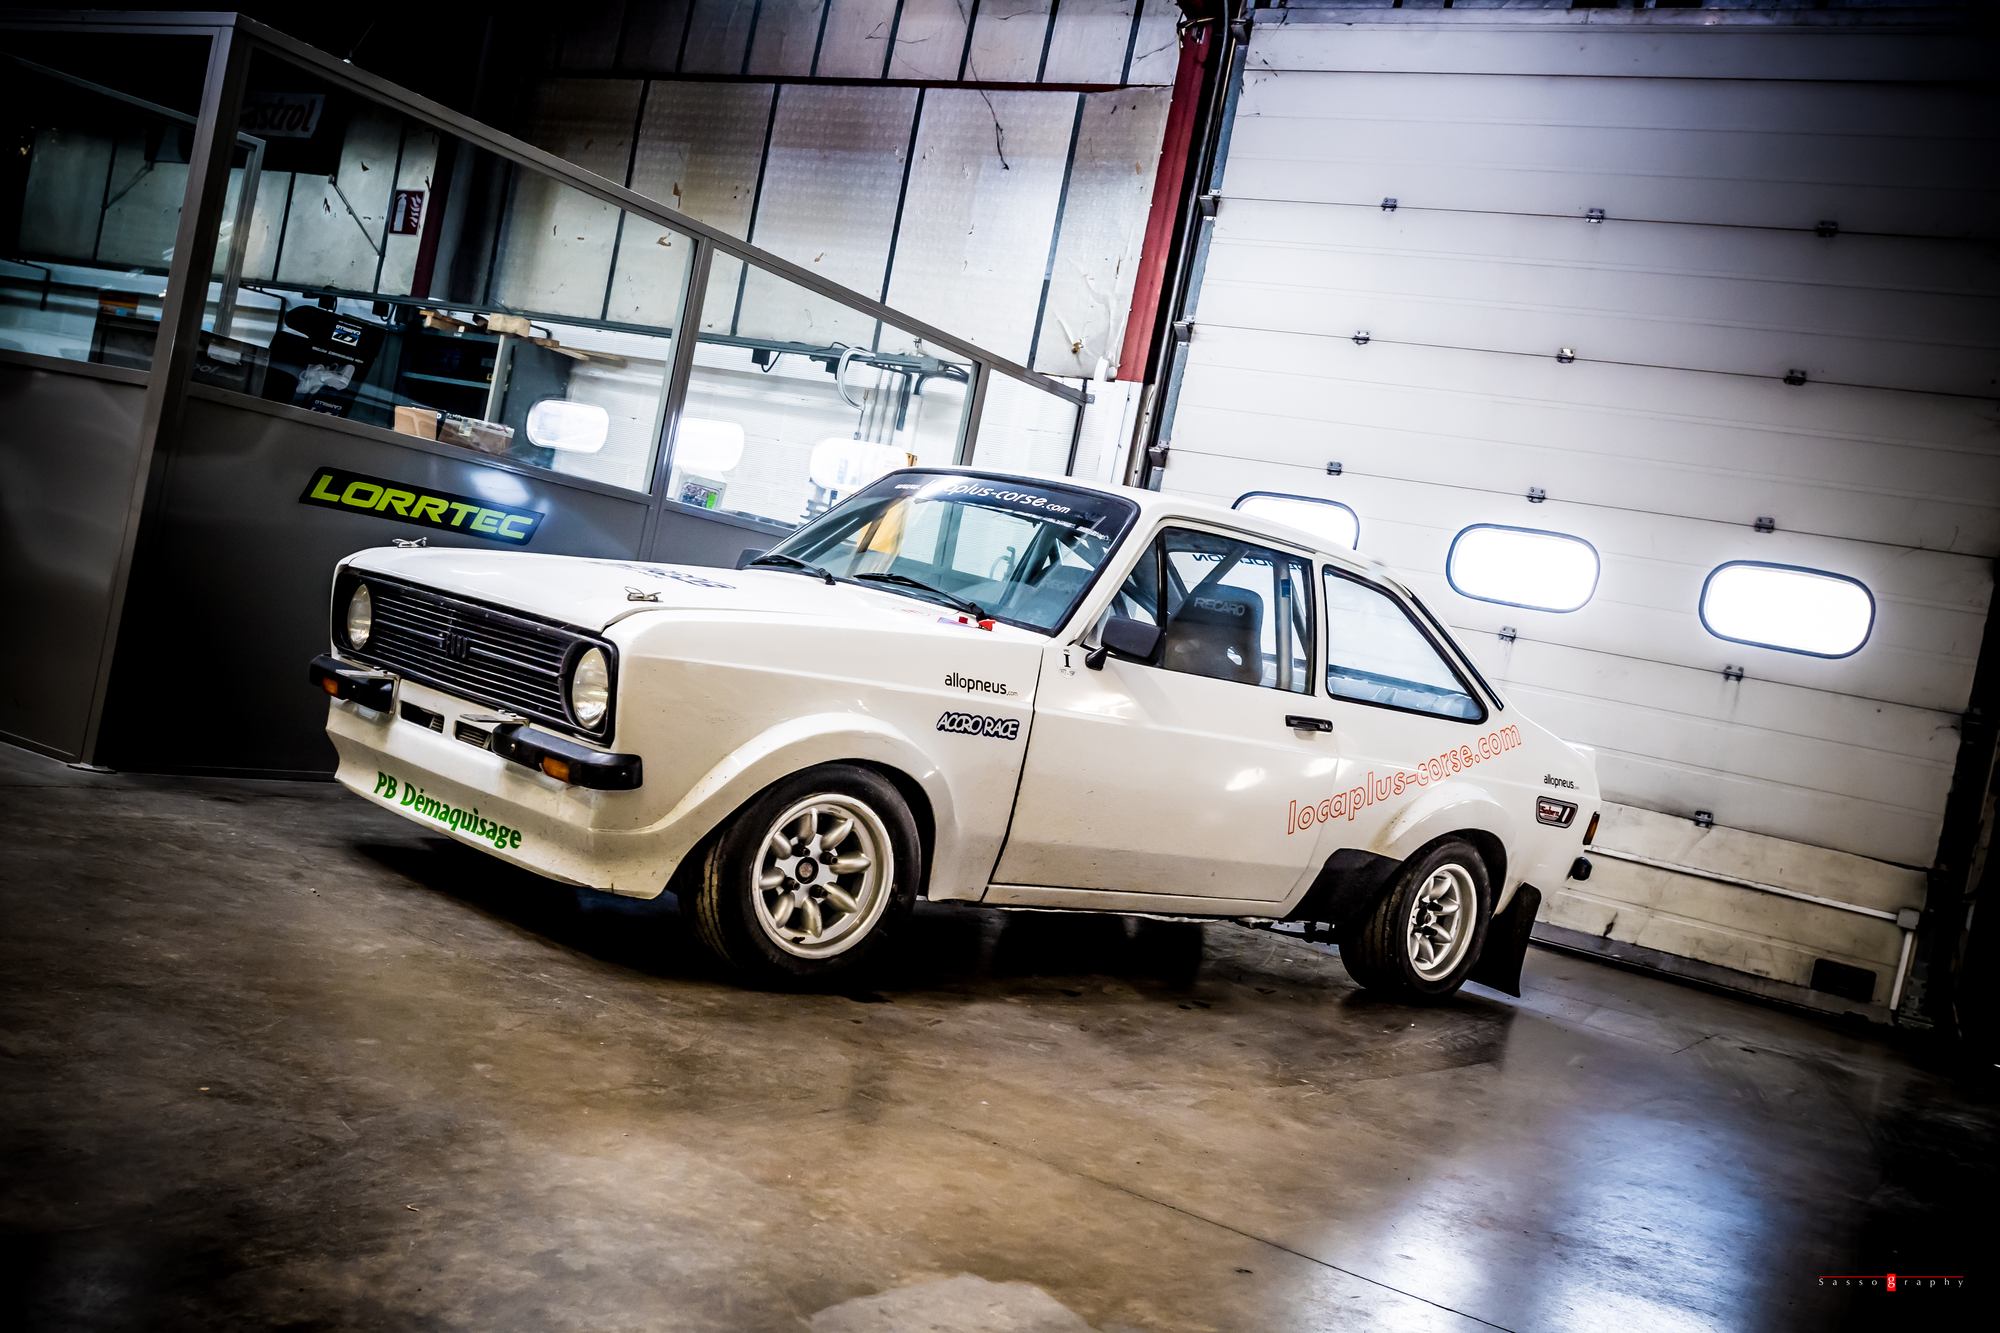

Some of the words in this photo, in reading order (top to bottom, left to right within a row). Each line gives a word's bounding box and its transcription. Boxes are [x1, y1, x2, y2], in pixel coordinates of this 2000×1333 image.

[239, 98, 316, 132] astrol
[310, 475, 533, 539] LORRTEC
[1194, 597, 1246, 616] RECARO
[983, 717, 1020, 740] RACE
[1288, 724, 1522, 834] locaplus-corse.com
[373, 771, 398, 799] PB
[400, 782, 522, 849] Démaquisage
